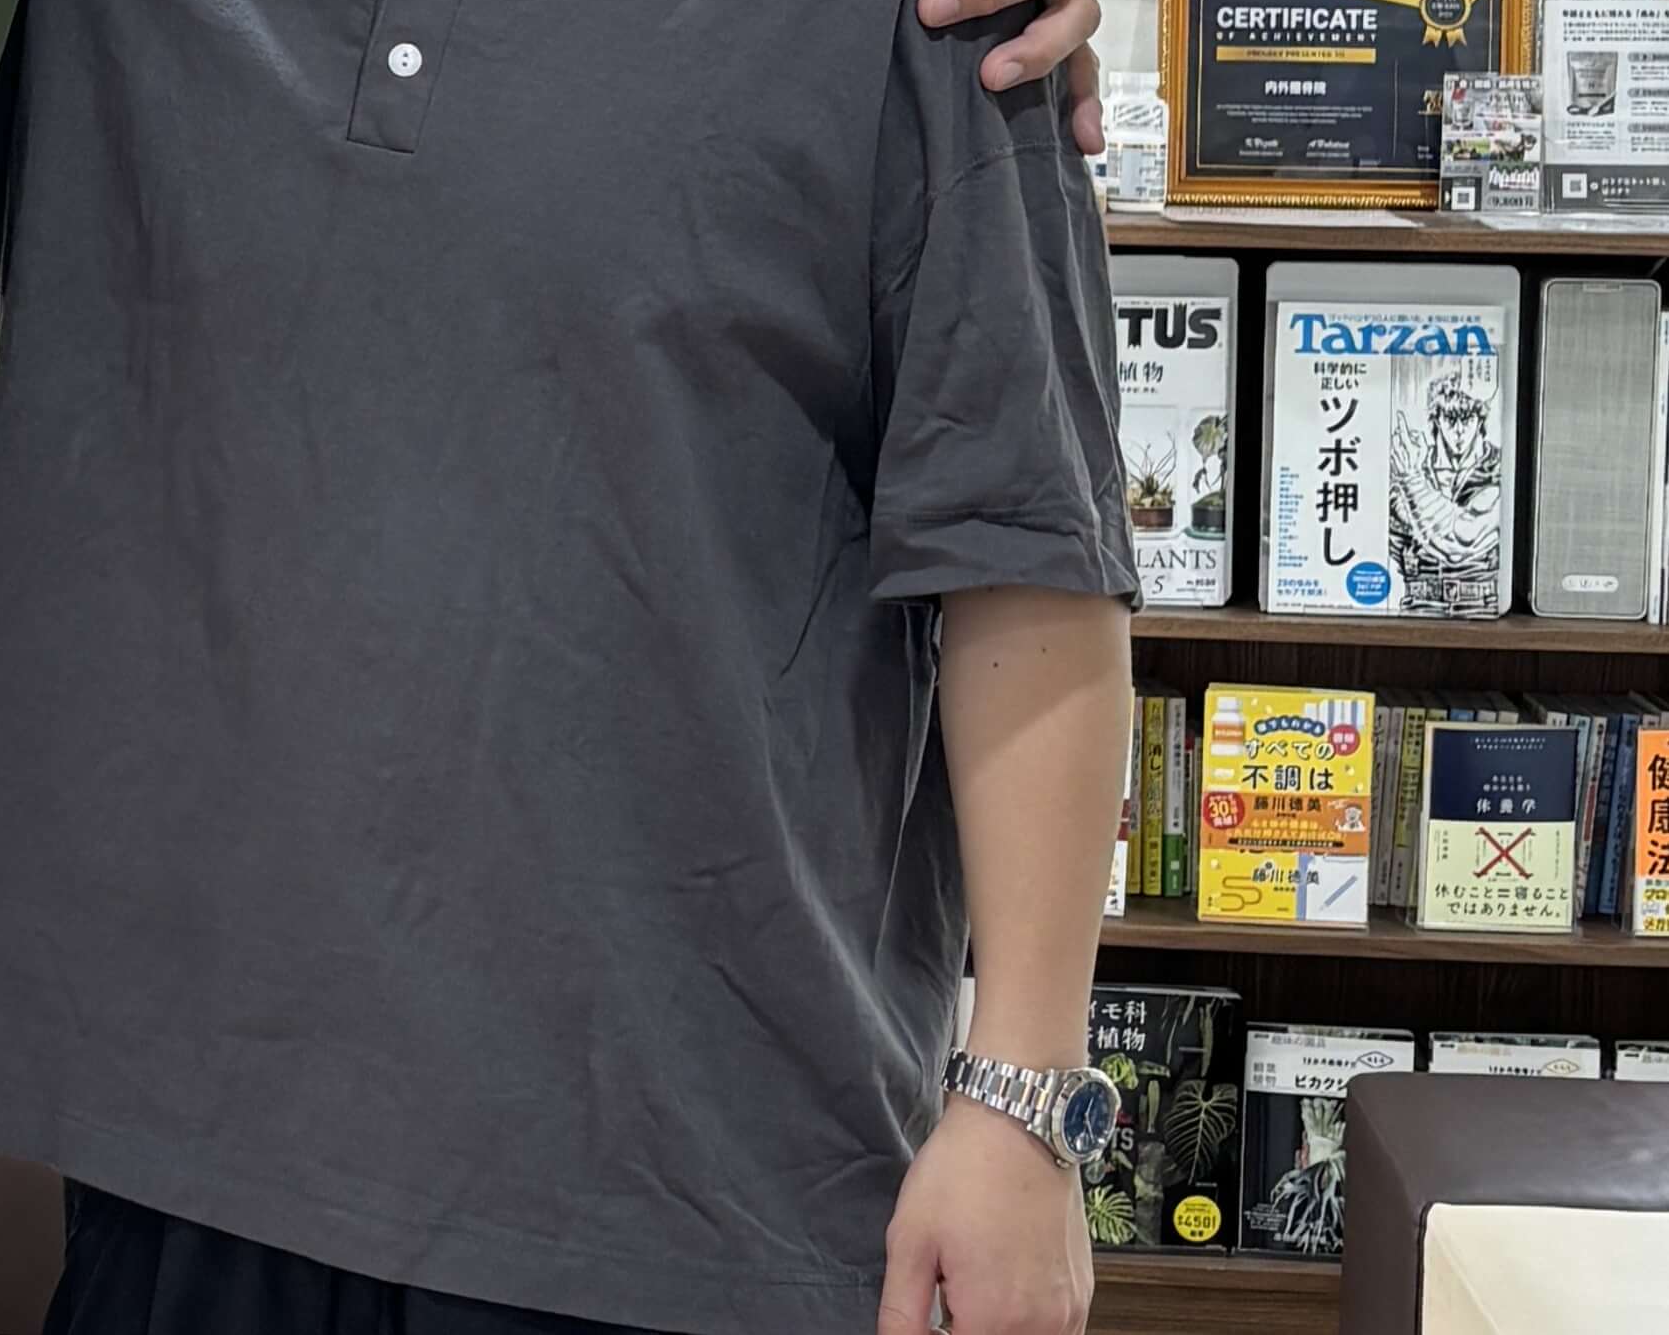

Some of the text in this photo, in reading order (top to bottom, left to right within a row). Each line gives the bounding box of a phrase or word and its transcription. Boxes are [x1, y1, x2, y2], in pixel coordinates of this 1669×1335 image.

[1216, 6, 1378, 30] CERTIFICATE
[1216, 31, 1377, 42] OF ACHIEVEMENT
[1113, 303, 1223, 350] TUS
[1289, 313, 1498, 356] Tarzan
[1314, 361, 1367, 376] 科学的に
[1321, 377, 1359, 391] 正しい
[1315, 396, 1361, 566] ツボ押し
[1245, 738, 1336, 762] すべての
[1242, 764, 1334, 791] 不調は
[1252, 796, 1321, 812] 藤川徳美
[1476, 797, 1537, 815] 休養学
[1252, 868, 1320, 885] 藤川徳美
[1434, 883, 1569, 901] 休むこと＝寝ること
[1447, 902, 1561, 918] ではありません。
[1088, 1026, 1146, 1052] 植物
